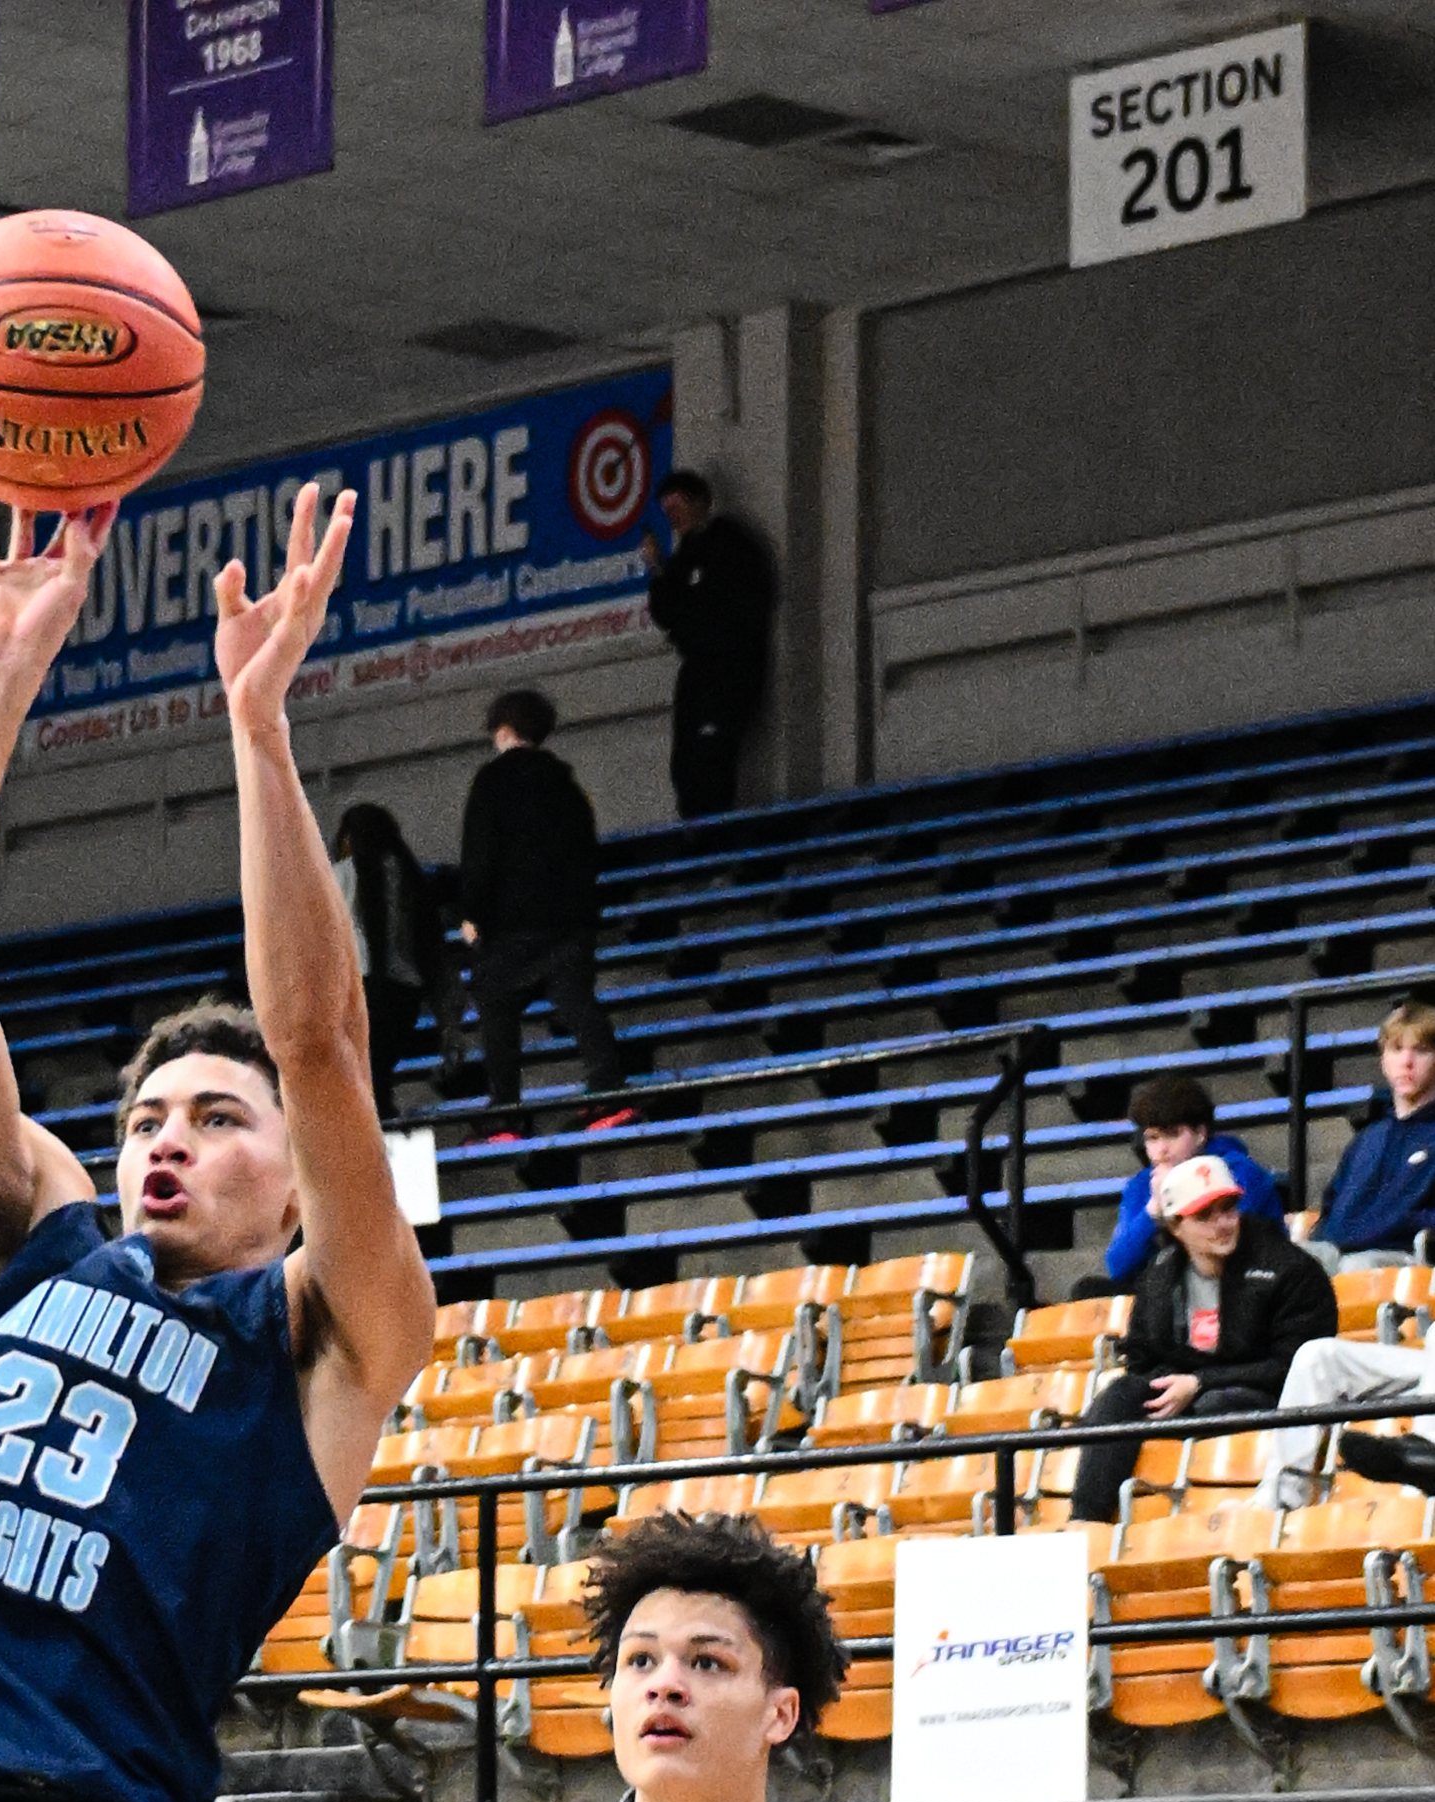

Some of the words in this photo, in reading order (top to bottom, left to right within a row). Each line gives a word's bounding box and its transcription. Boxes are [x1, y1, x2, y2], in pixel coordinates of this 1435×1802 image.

[204, 30, 263, 73] 1968
[1090, 53, 1283, 139] SECTION
[1121, 127, 1254, 226] 201
[64, 469, 344, 647] DVERTIS
[367, 425, 530, 581] HERE
[931, 1630, 1075, 1663] TANAGER
[998, 1651, 1067, 1667] SPORTS
